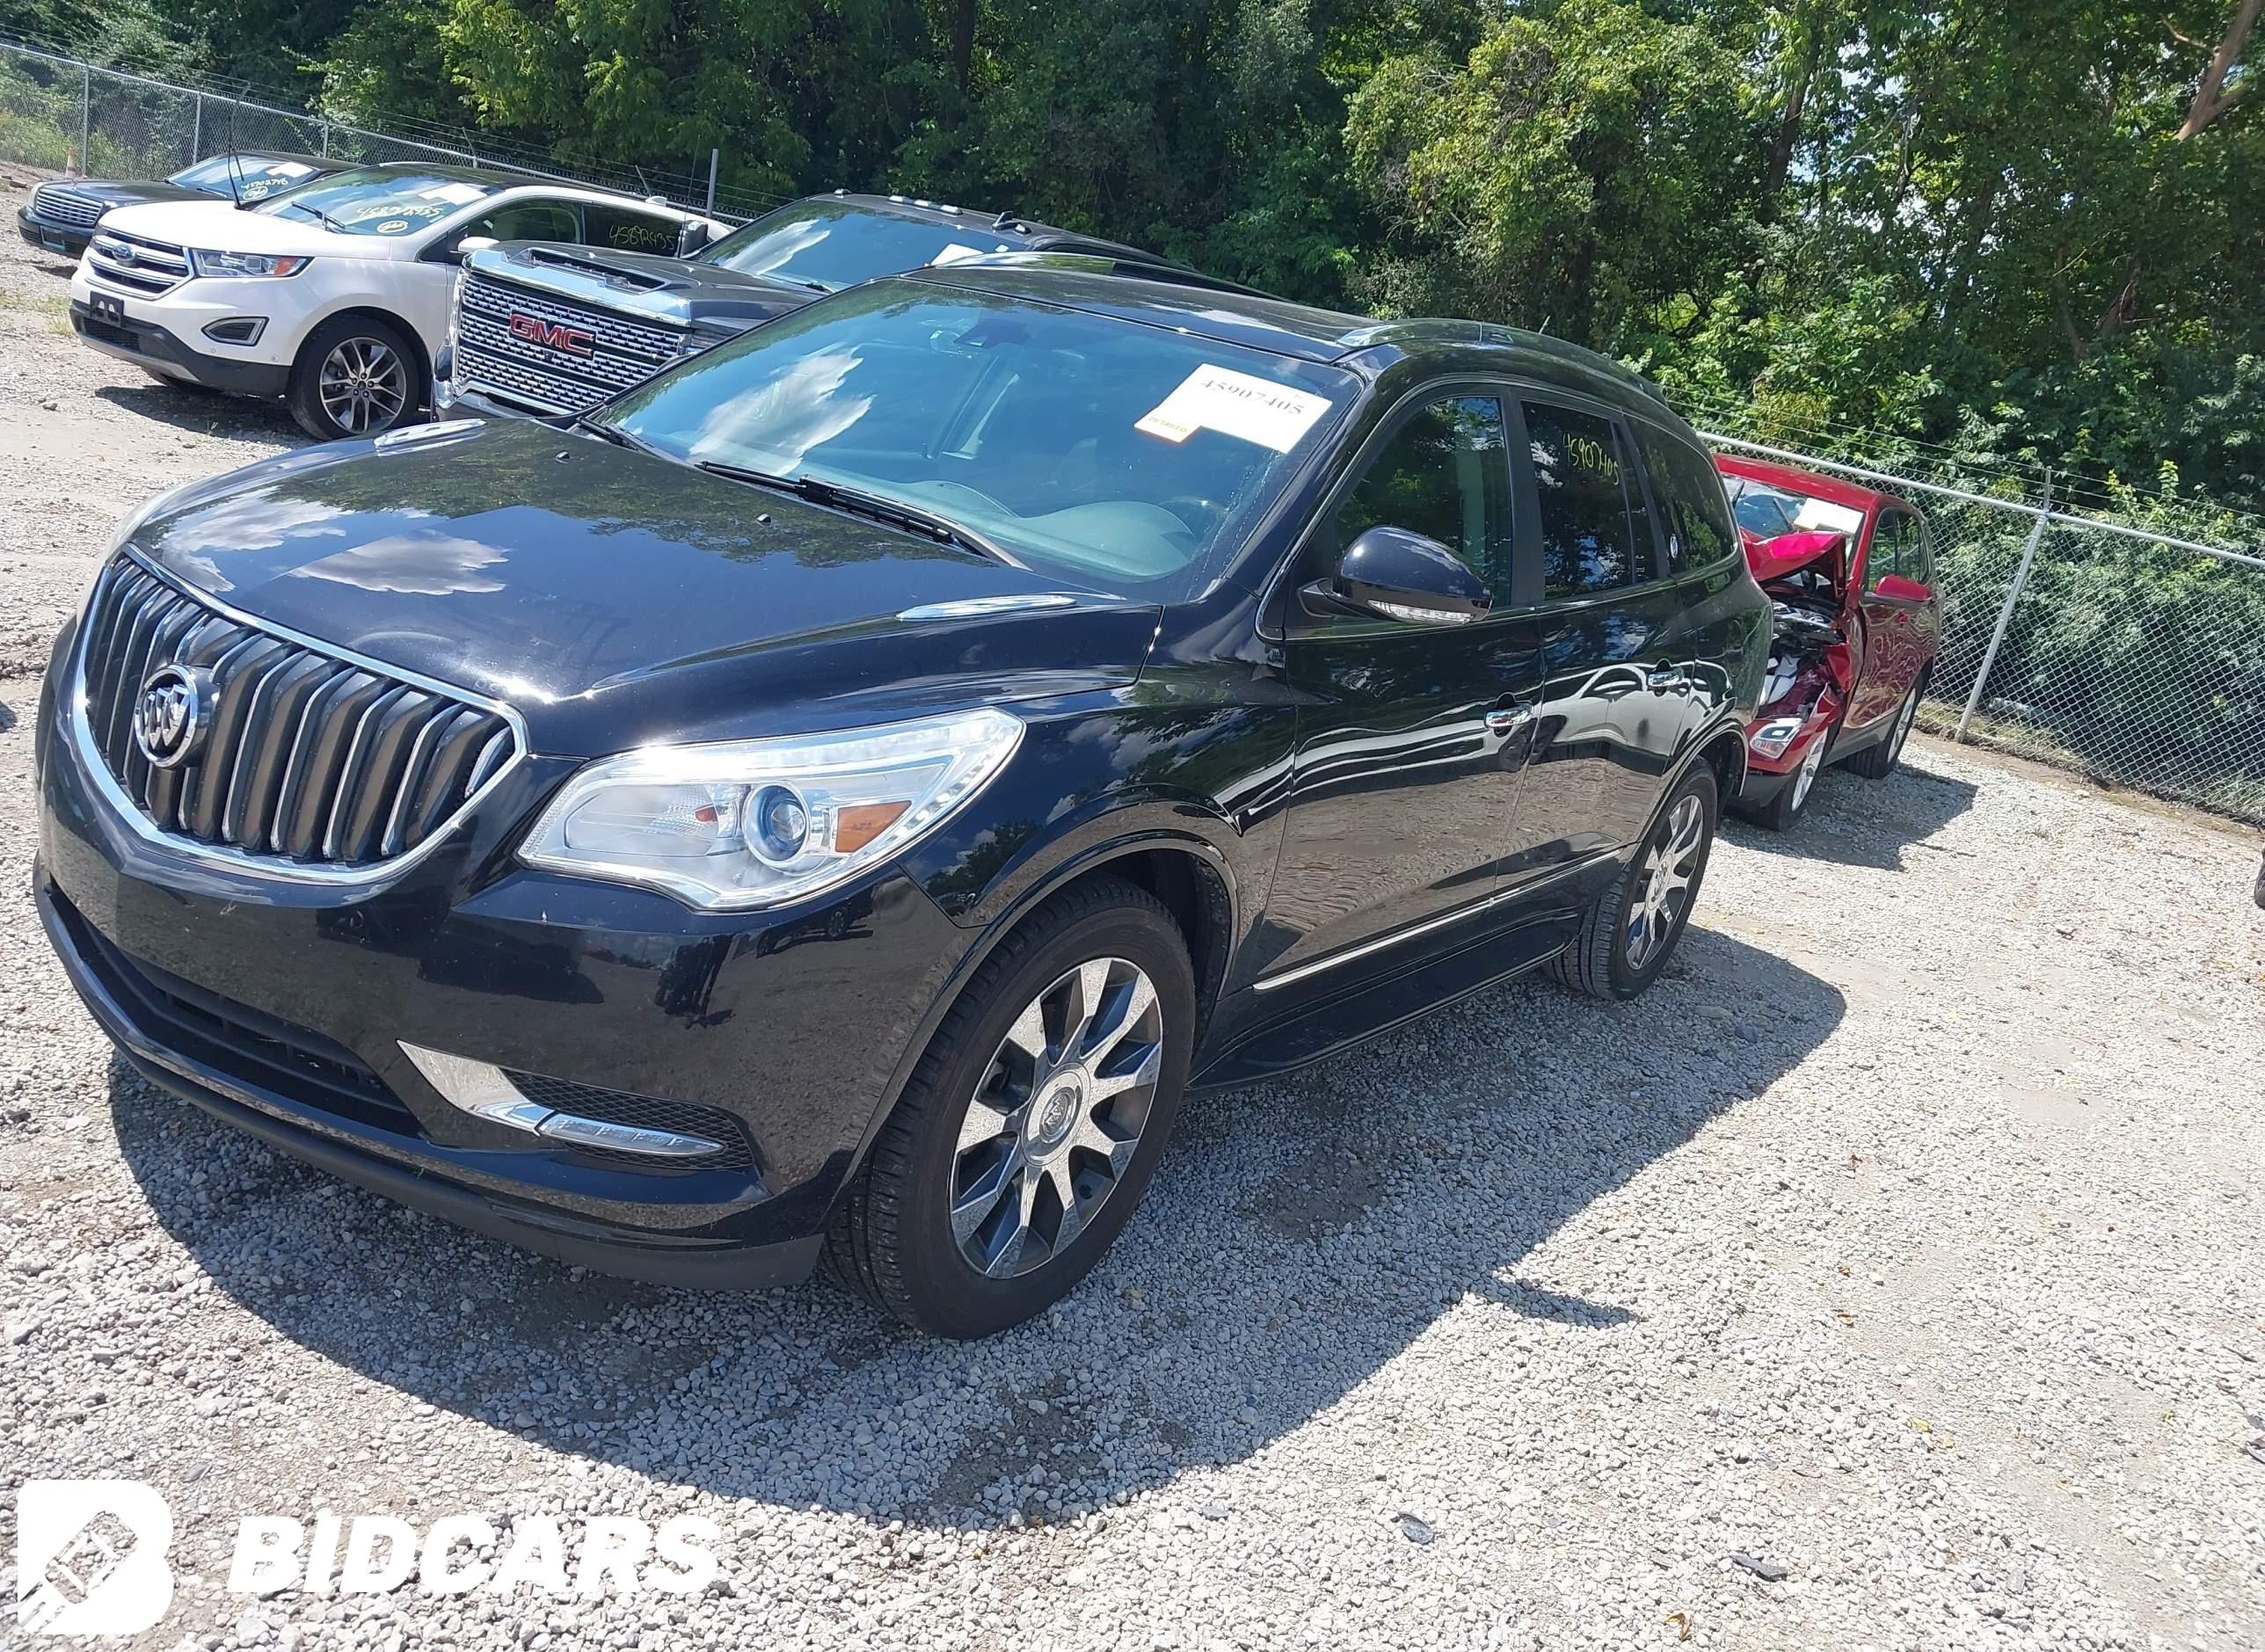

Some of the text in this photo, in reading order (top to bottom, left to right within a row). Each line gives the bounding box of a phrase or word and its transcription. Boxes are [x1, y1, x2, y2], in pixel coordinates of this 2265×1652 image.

[510, 313, 594, 356] GMC
[1199, 379, 1306, 415] 45907405
[1562, 433, 1620, 485] 45907405
